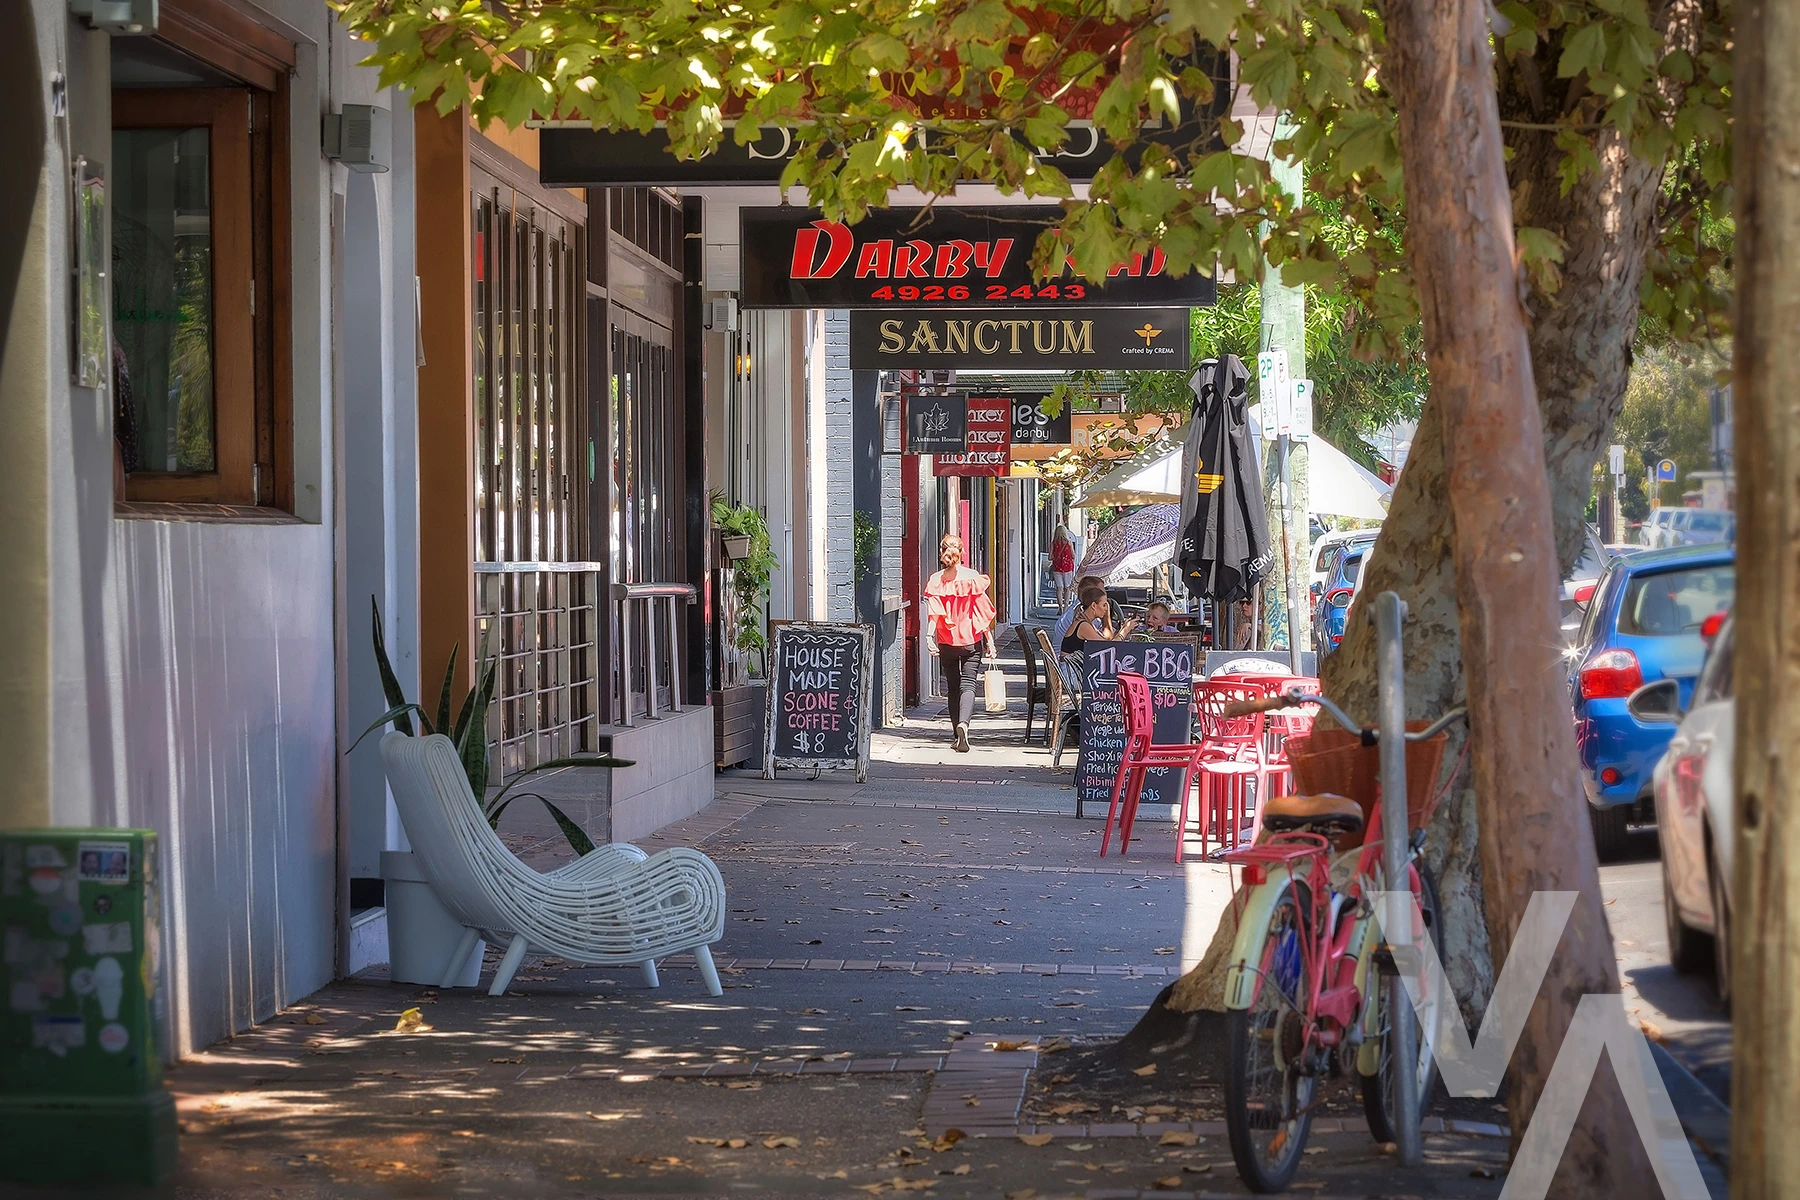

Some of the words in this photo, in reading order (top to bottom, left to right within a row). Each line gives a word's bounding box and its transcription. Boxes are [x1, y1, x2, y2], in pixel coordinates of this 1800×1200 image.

[789, 218, 1015, 279] DARBY
[870, 284, 971, 300] 4926
[984, 284, 1087, 300] 2443
[878, 319, 1096, 354] SANCTUM
[1145, 347, 1154, 355] by
[1260, 358, 1273, 379] 2P
[1012, 397, 1049, 426] ies
[1015, 427, 1050, 440] darby
[1248, 546, 1274, 579] REMA
[785, 645, 846, 669] HOUSE
[1089, 646, 1137, 675] The
[1143, 647, 1192, 681] BBQ
[789, 670, 841, 691] MADE
[783, 691, 840, 712] SCONE
[1154, 692, 1177, 709] $10
[788, 713, 842, 731] COFFEE
